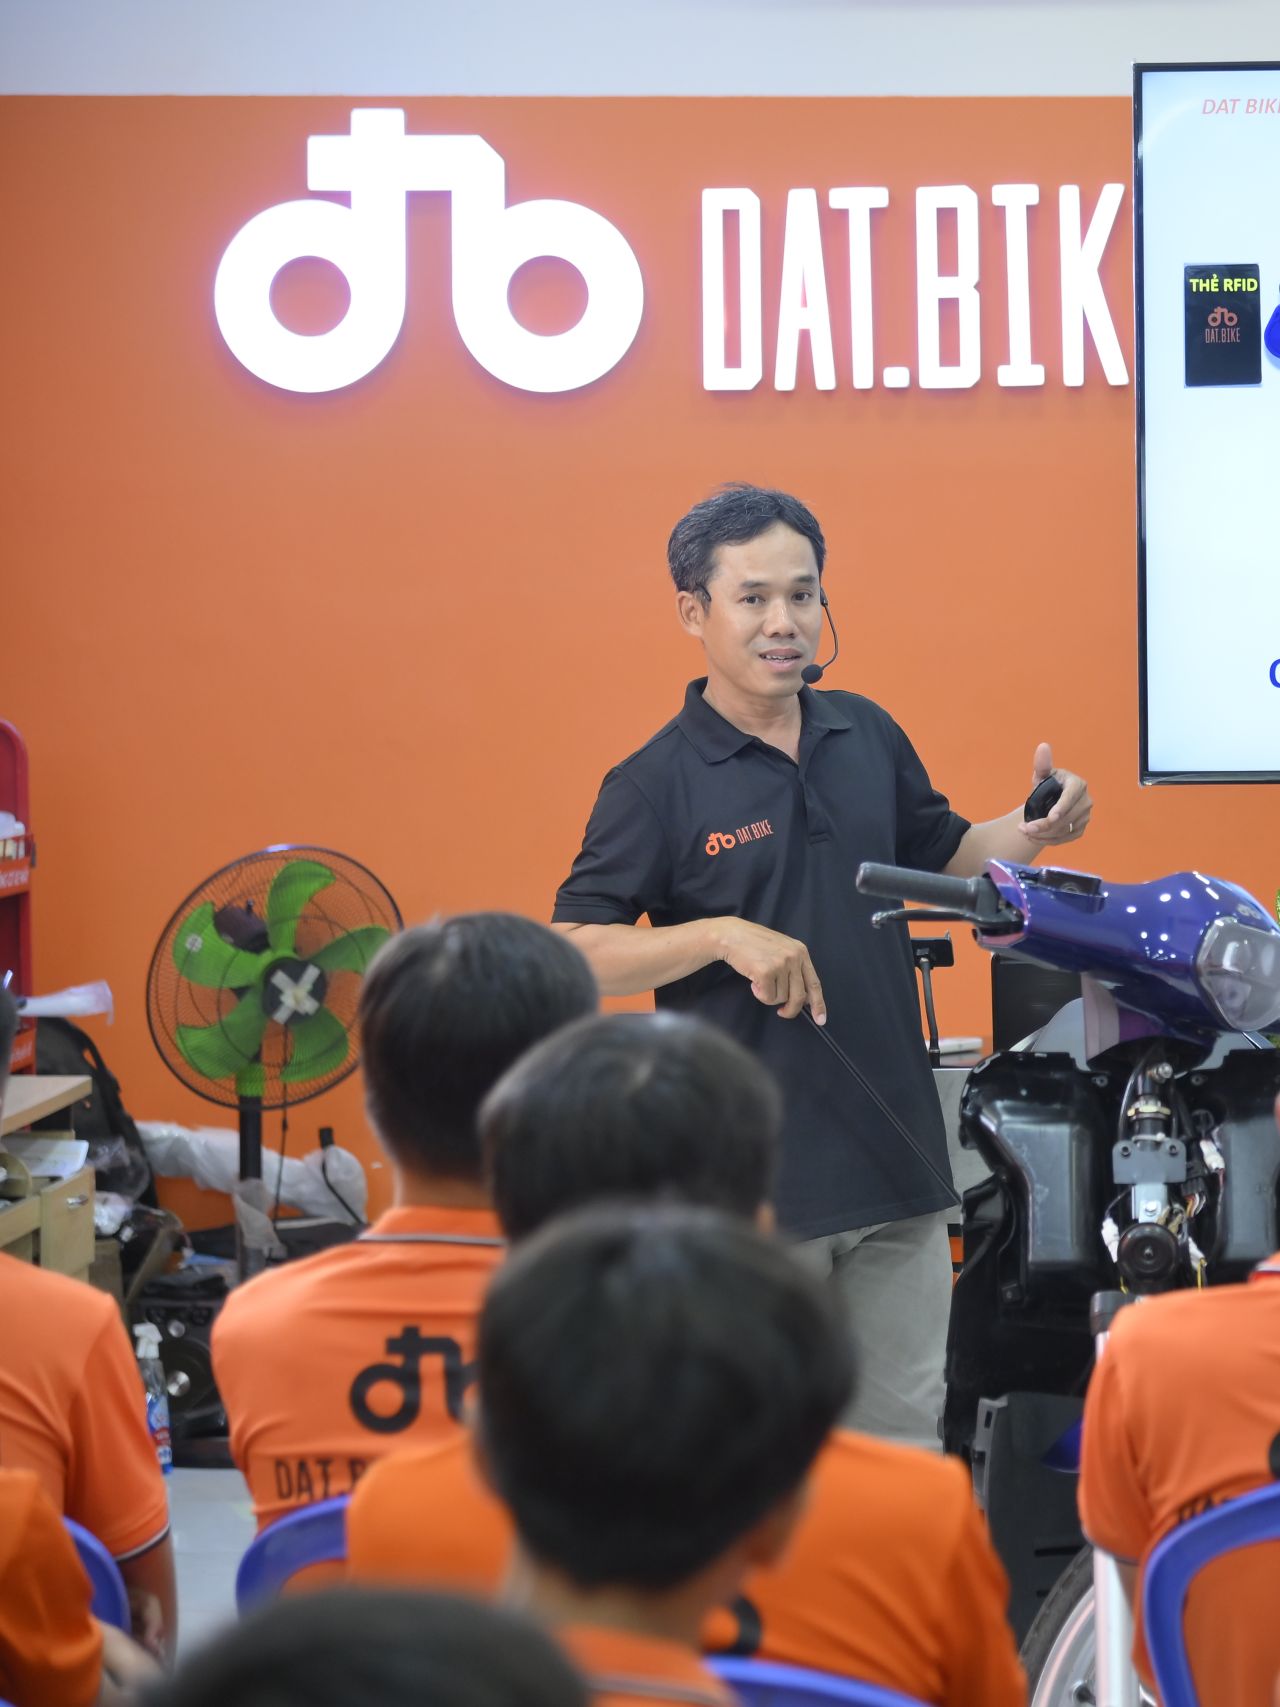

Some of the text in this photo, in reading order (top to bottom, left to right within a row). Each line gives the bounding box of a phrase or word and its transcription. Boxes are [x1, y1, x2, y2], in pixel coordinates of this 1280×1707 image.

[1202, 98, 1240, 115] DAT
[701, 183, 1130, 391] DAT.BIK
[1189, 273, 1258, 292] THẺ RFID
[1205, 327, 1241, 344] DAT.BIKE
[735, 818, 774, 845] DAT.BIKE
